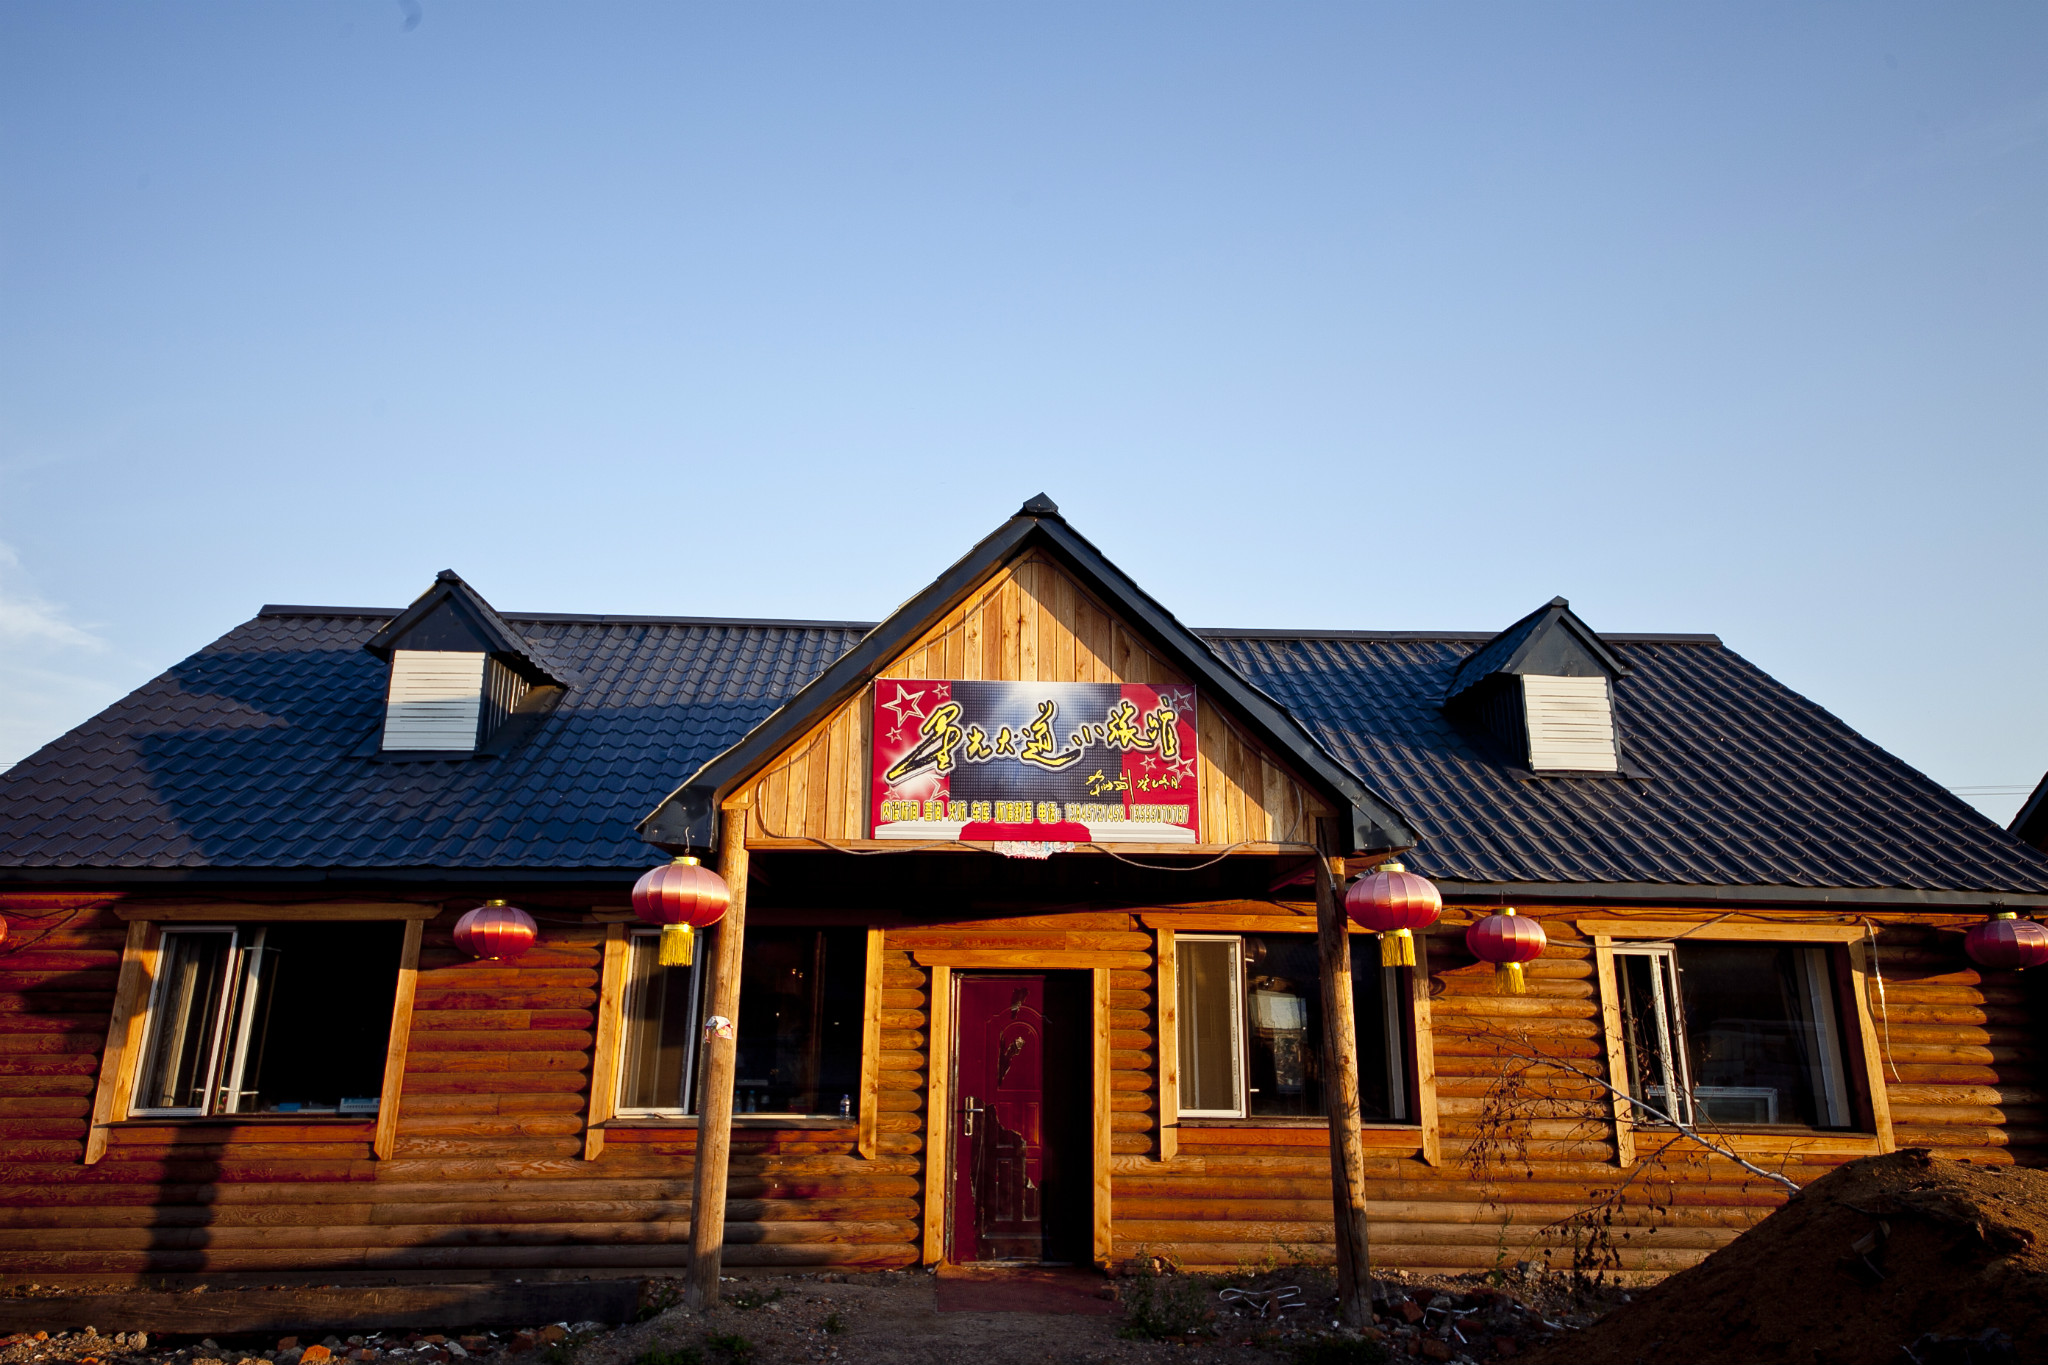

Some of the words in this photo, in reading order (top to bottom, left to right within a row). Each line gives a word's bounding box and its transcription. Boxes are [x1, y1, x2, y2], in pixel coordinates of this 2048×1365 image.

[881, 800, 920, 822] 内设标间
[924, 800, 943, 822] 普间
[972, 801, 991, 823] 车库
[995, 801, 1033, 823] 环境舒适
